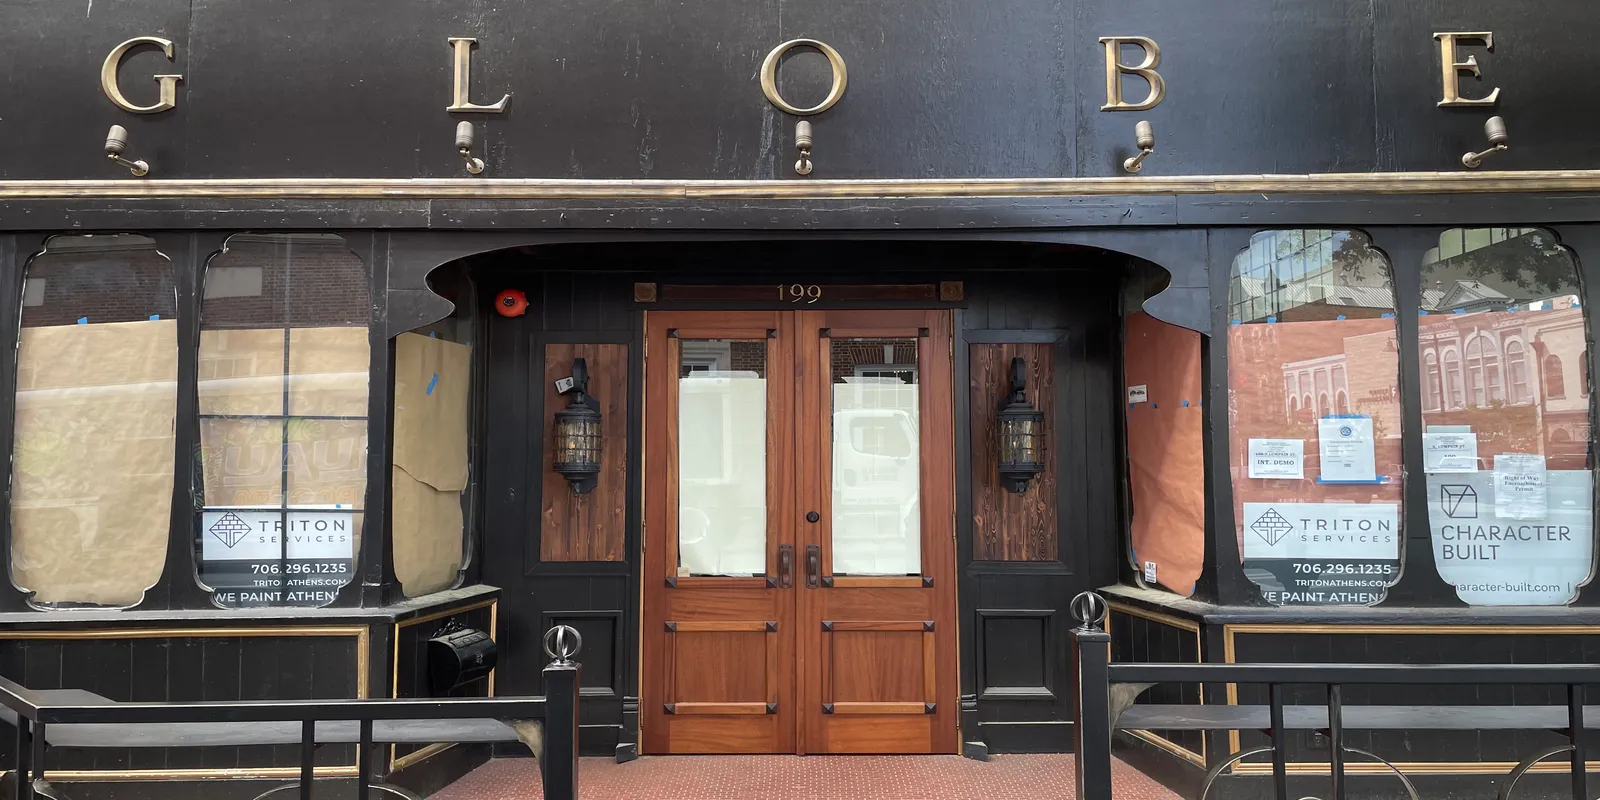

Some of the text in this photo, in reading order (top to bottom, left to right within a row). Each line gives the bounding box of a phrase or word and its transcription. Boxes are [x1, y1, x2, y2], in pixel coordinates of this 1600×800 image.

[101, 32, 1500, 113] GLOBE
[777, 283, 822, 304] 199
[258, 519, 345, 532] TRITON
[1299, 518, 1391, 531] TRITON
[1441, 525, 1571, 541] CHARACTER
[1301, 535, 1391, 543] SERVICES
[1442, 545, 1500, 560] BUILT
[251, 563, 347, 574] 706.296.1235
[1293, 563, 1392, 574] 706.296.1235
[253, 579, 347, 587] TRITOATHENS.COM
[1452, 582, 1560, 592] aracter-built.com
[240, 592, 281, 602] PAINT
[286, 591, 336, 601] ATHEN
[1281, 592, 1325, 602] PAINT
